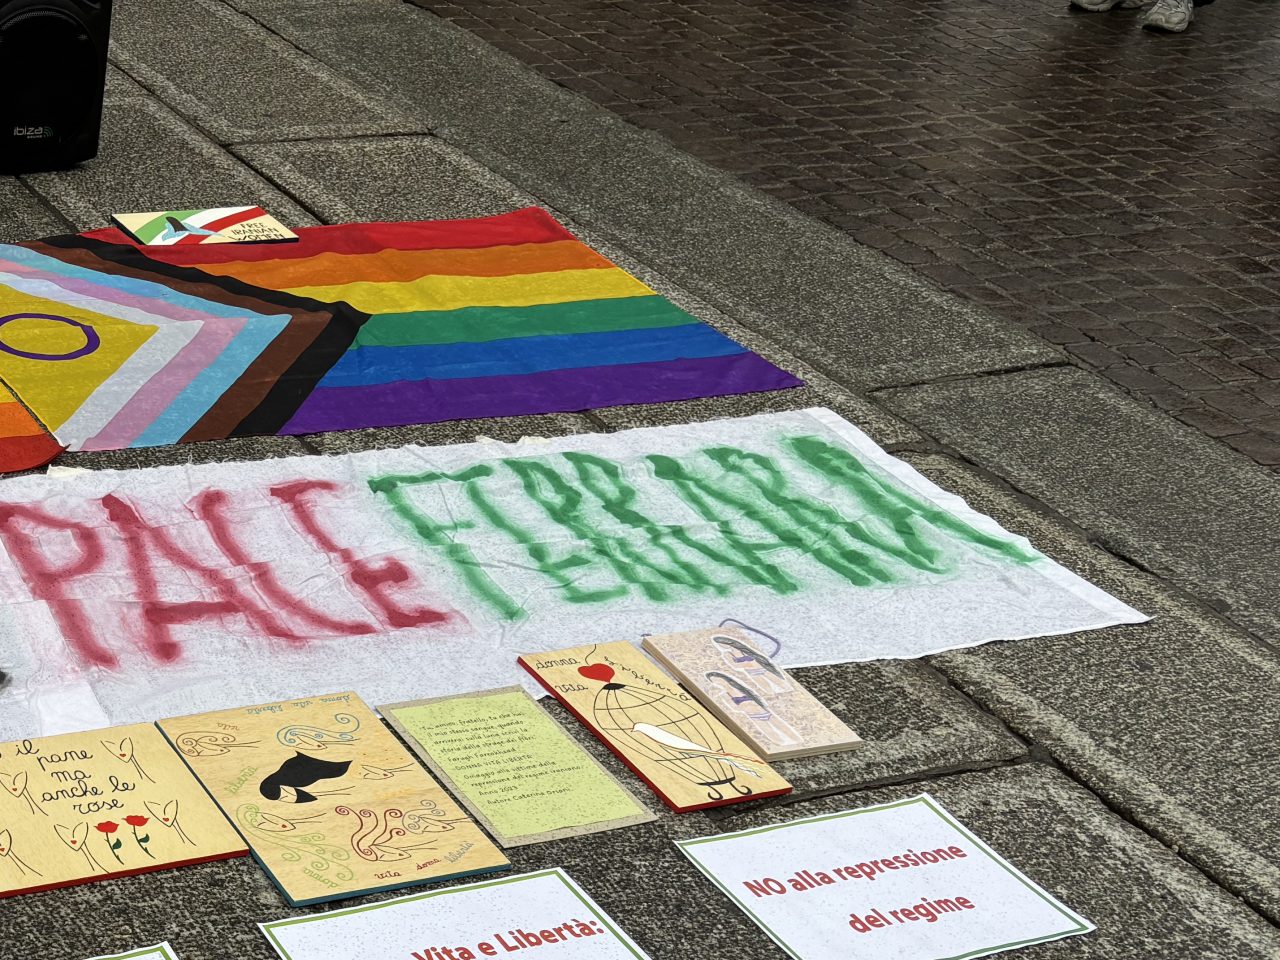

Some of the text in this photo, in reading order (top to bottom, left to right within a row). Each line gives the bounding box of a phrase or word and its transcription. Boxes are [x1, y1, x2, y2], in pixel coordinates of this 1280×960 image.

[14, 126, 43, 136] ibiza
[536, 657, 580, 670] donna
[555, 683, 588, 694] vita
[16, 740, 40, 756] il
[37, 750, 93, 771] pane
[51, 769, 91, 783] ma
[41, 775, 136, 803] anche le
[73, 798, 124, 814] rose
[374, 871, 402, 880] vita
[744, 846, 965, 897] NO alla repressione
[849, 896, 975, 934] del regime
[477, 941, 498, 957] e
[494, 919, 605, 953] Libertà:
